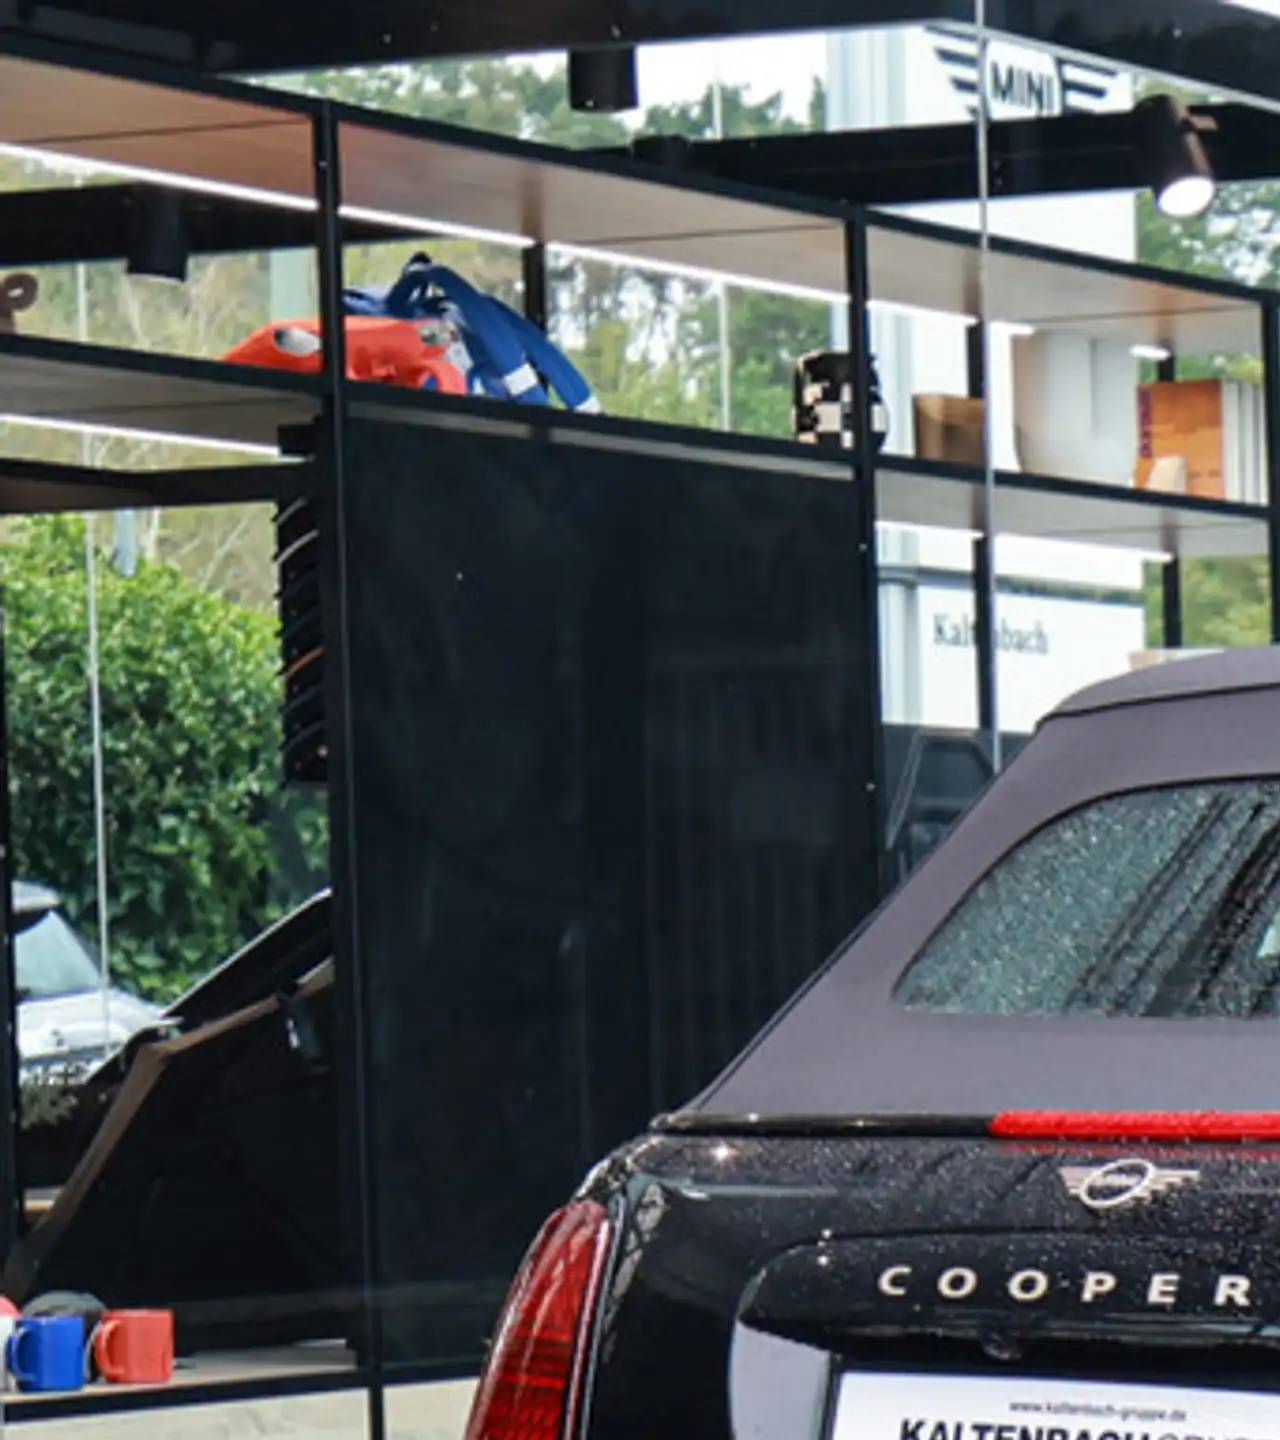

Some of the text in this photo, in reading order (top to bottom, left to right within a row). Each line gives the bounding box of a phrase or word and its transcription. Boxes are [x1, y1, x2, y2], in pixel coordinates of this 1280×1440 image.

[990, 61, 1055, 118] MINI
[877, 1263, 1252, 1307] COOPER
[1009, 1401, 1187, 1423] www.kaltenbach-gruppe.de
